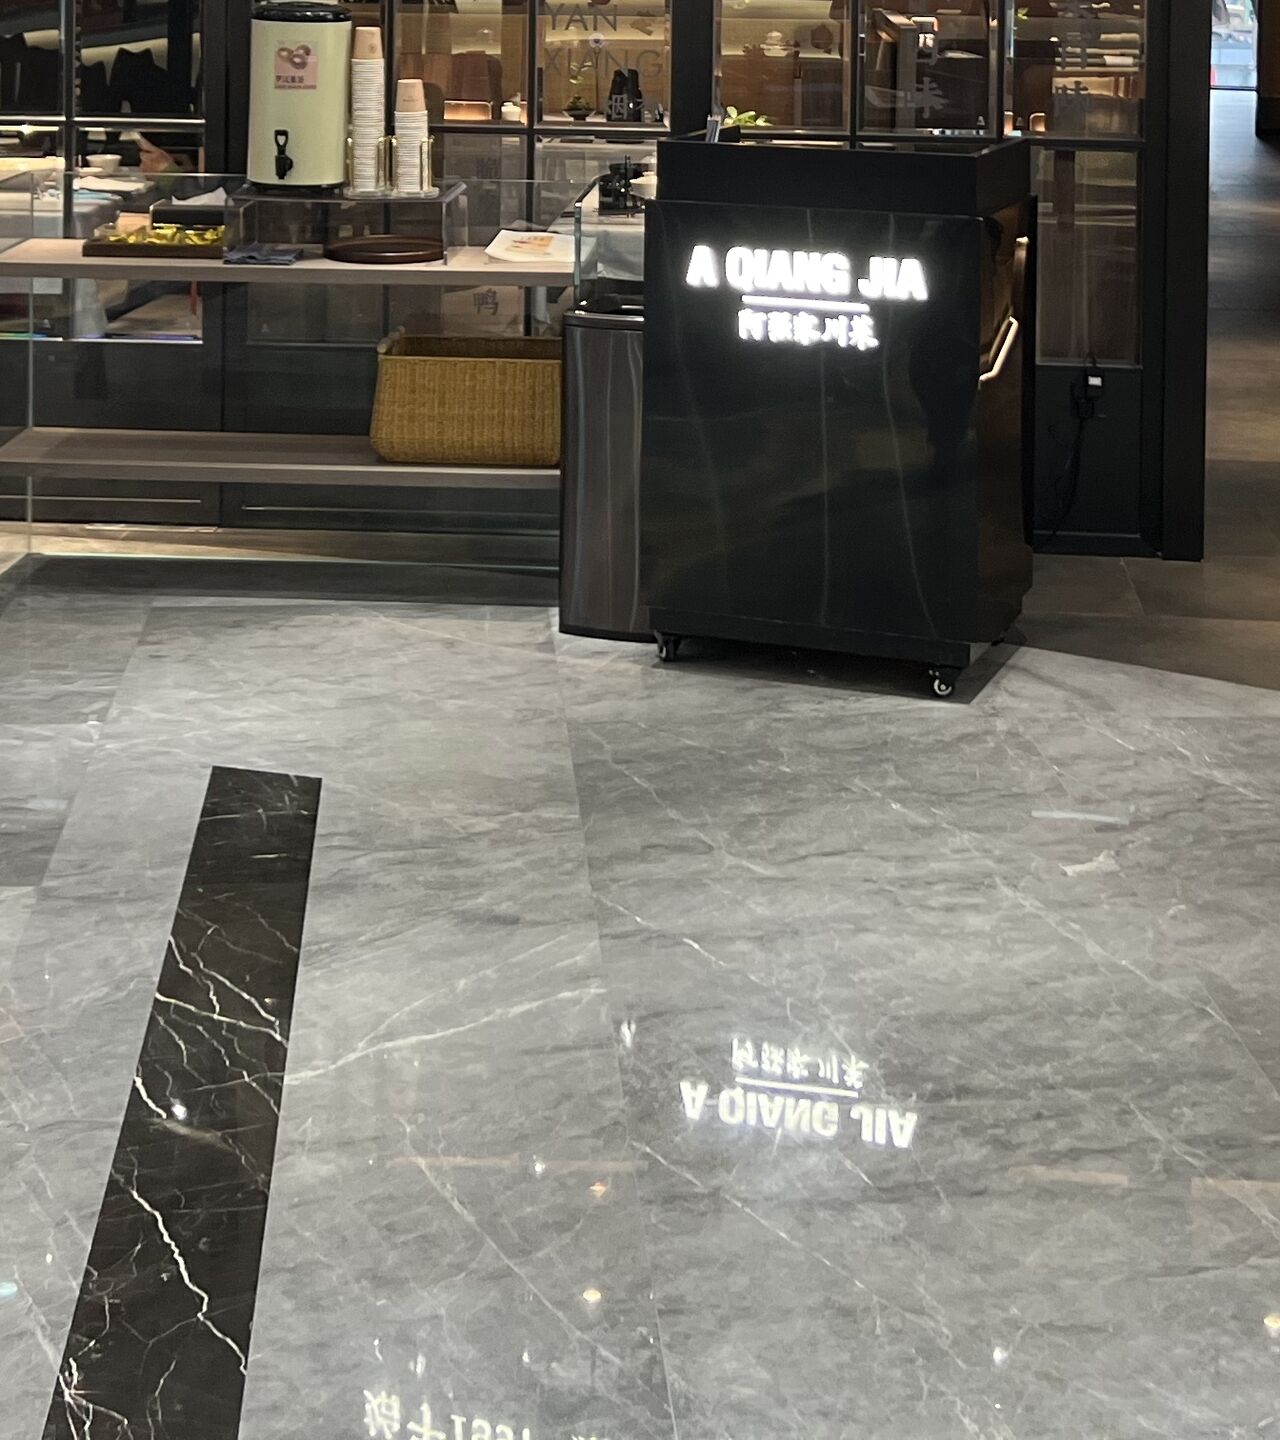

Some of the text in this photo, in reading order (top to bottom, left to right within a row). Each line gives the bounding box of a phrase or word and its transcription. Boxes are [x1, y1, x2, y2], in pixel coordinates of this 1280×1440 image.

[685, 244, 929, 302] A QIANG JIA
